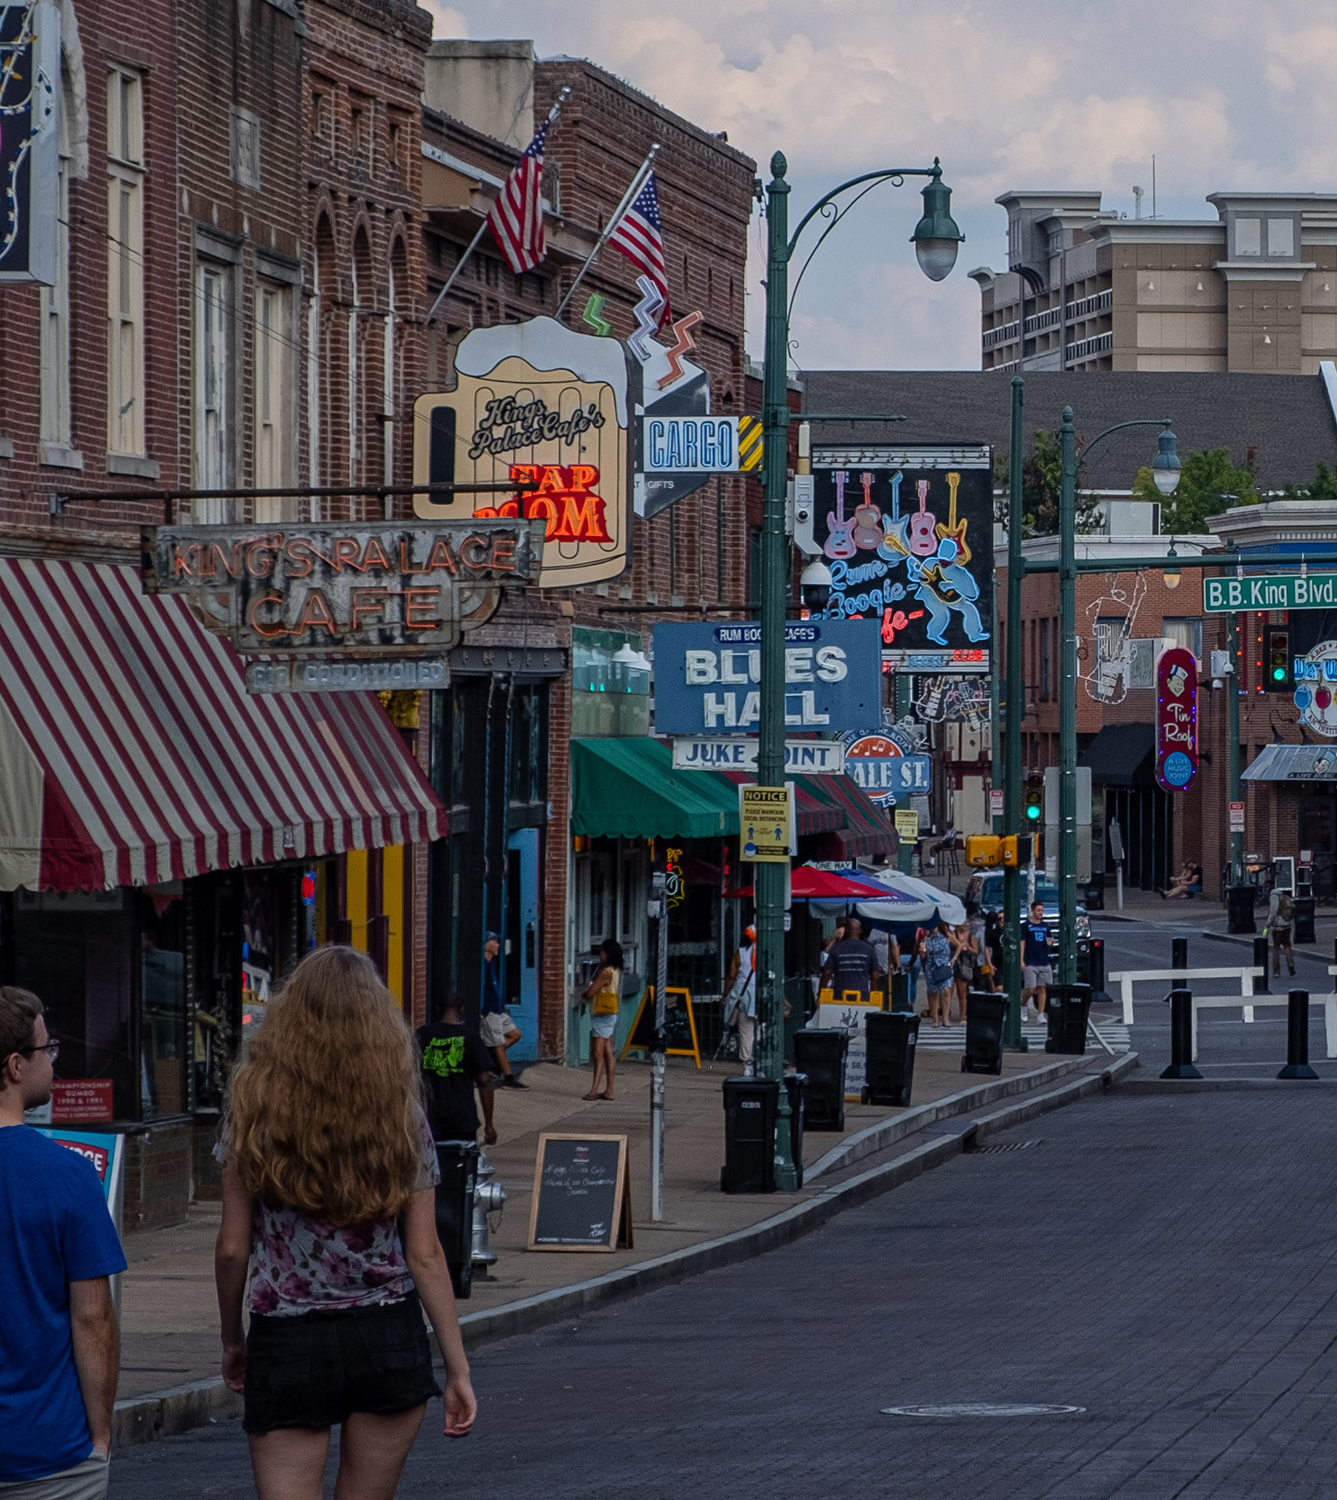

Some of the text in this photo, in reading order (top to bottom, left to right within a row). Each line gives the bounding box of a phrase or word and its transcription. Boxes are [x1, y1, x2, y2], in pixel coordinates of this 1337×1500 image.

[480, 396, 547, 431] Kings
[468, 404, 605, 460] Palace Cafe's
[650, 420, 733, 468] CARGO
[511, 465, 599, 497] TAP
[647, 480, 675, 489] GIFTS
[1209, 579, 1337, 607] B.B. King Blvd.
[249, 587, 441, 637] CAFE
[719, 628, 742, 641] RUM
[1167, 703, 1190, 722] Tin
[1163, 723, 1193, 750] Roof
[685, 743, 831, 766] JUKE INT
[844, 761, 928, 787] ALE ST.
[745, 791, 785, 801] NOTICE
[816, 861, 850, 869] ONE WAY
